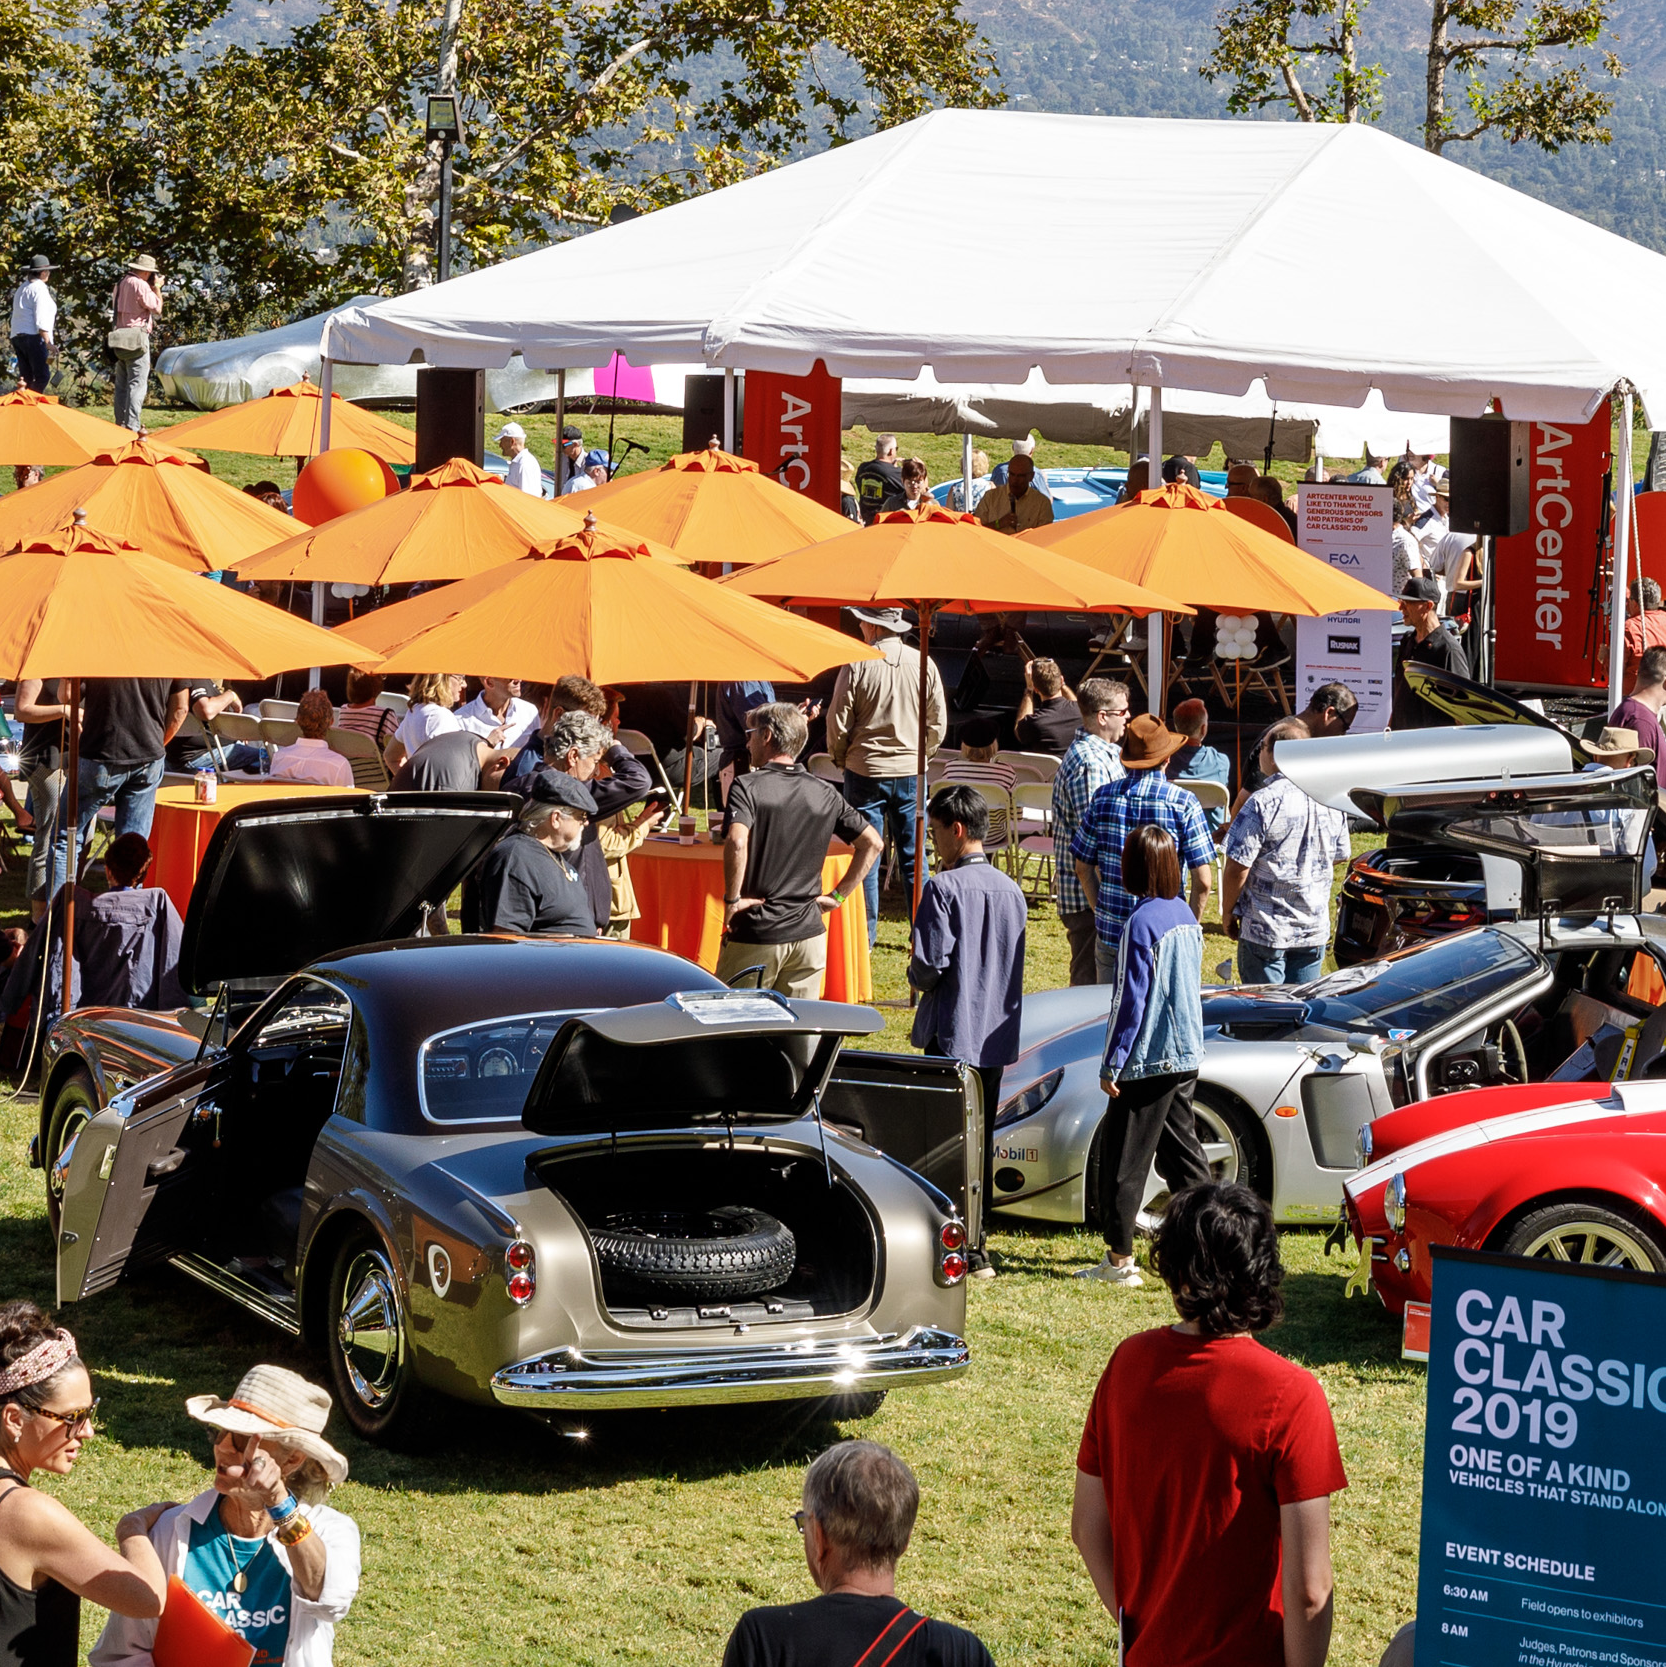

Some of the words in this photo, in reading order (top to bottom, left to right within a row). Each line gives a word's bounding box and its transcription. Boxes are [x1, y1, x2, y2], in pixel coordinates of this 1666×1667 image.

[1306, 493, 1347, 501] ARTCENTER
[1536, 422, 1573, 650] ArtCenter
[1329, 553, 1360, 565] FCA
[993, 1146, 1025, 1160] Mobil
[1456, 1289, 1566, 1349] CAR
[1451, 1387, 1578, 1449] 2019
[1449, 1444, 1502, 1473] ONE
[1507, 1454, 1541, 1477] OF
[1545, 1461, 1563, 1483] A
[1568, 1464, 1631, 1491] KIND
[1449, 1469, 1524, 1495] VEHICLES
[1527, 1483, 1566, 1502] THAT
[1570, 1490, 1623, 1509] STAND
[1445, 1542, 1500, 1564] EVENT
[1504, 1552, 1595, 1581] SCHEDULE
[197, 1590, 242, 1610] CAR
[1443, 1584, 1468, 1599] 6:30
[1469, 1589, 1488, 1602] AM
[218, 1605, 286, 1628] ASSIC
[1521, 1598, 1546, 1612] Field
[1547, 1604, 1579, 1619] opens
[1581, 1608, 1591, 1619] to
[1593, 1610, 1644, 1629] exhibitors
[1441, 1623, 1448, 1633] 8
[1449, 1625, 1468, 1637] AM
[1518, 1652, 1528, 1662] in
[1529, 1654, 1544, 1666] the
[1519, 1636, 1557, 1655] Judges,
[1559, 1644, 1597, 1661] Patrons
[1599, 1650, 1618, 1664] and
